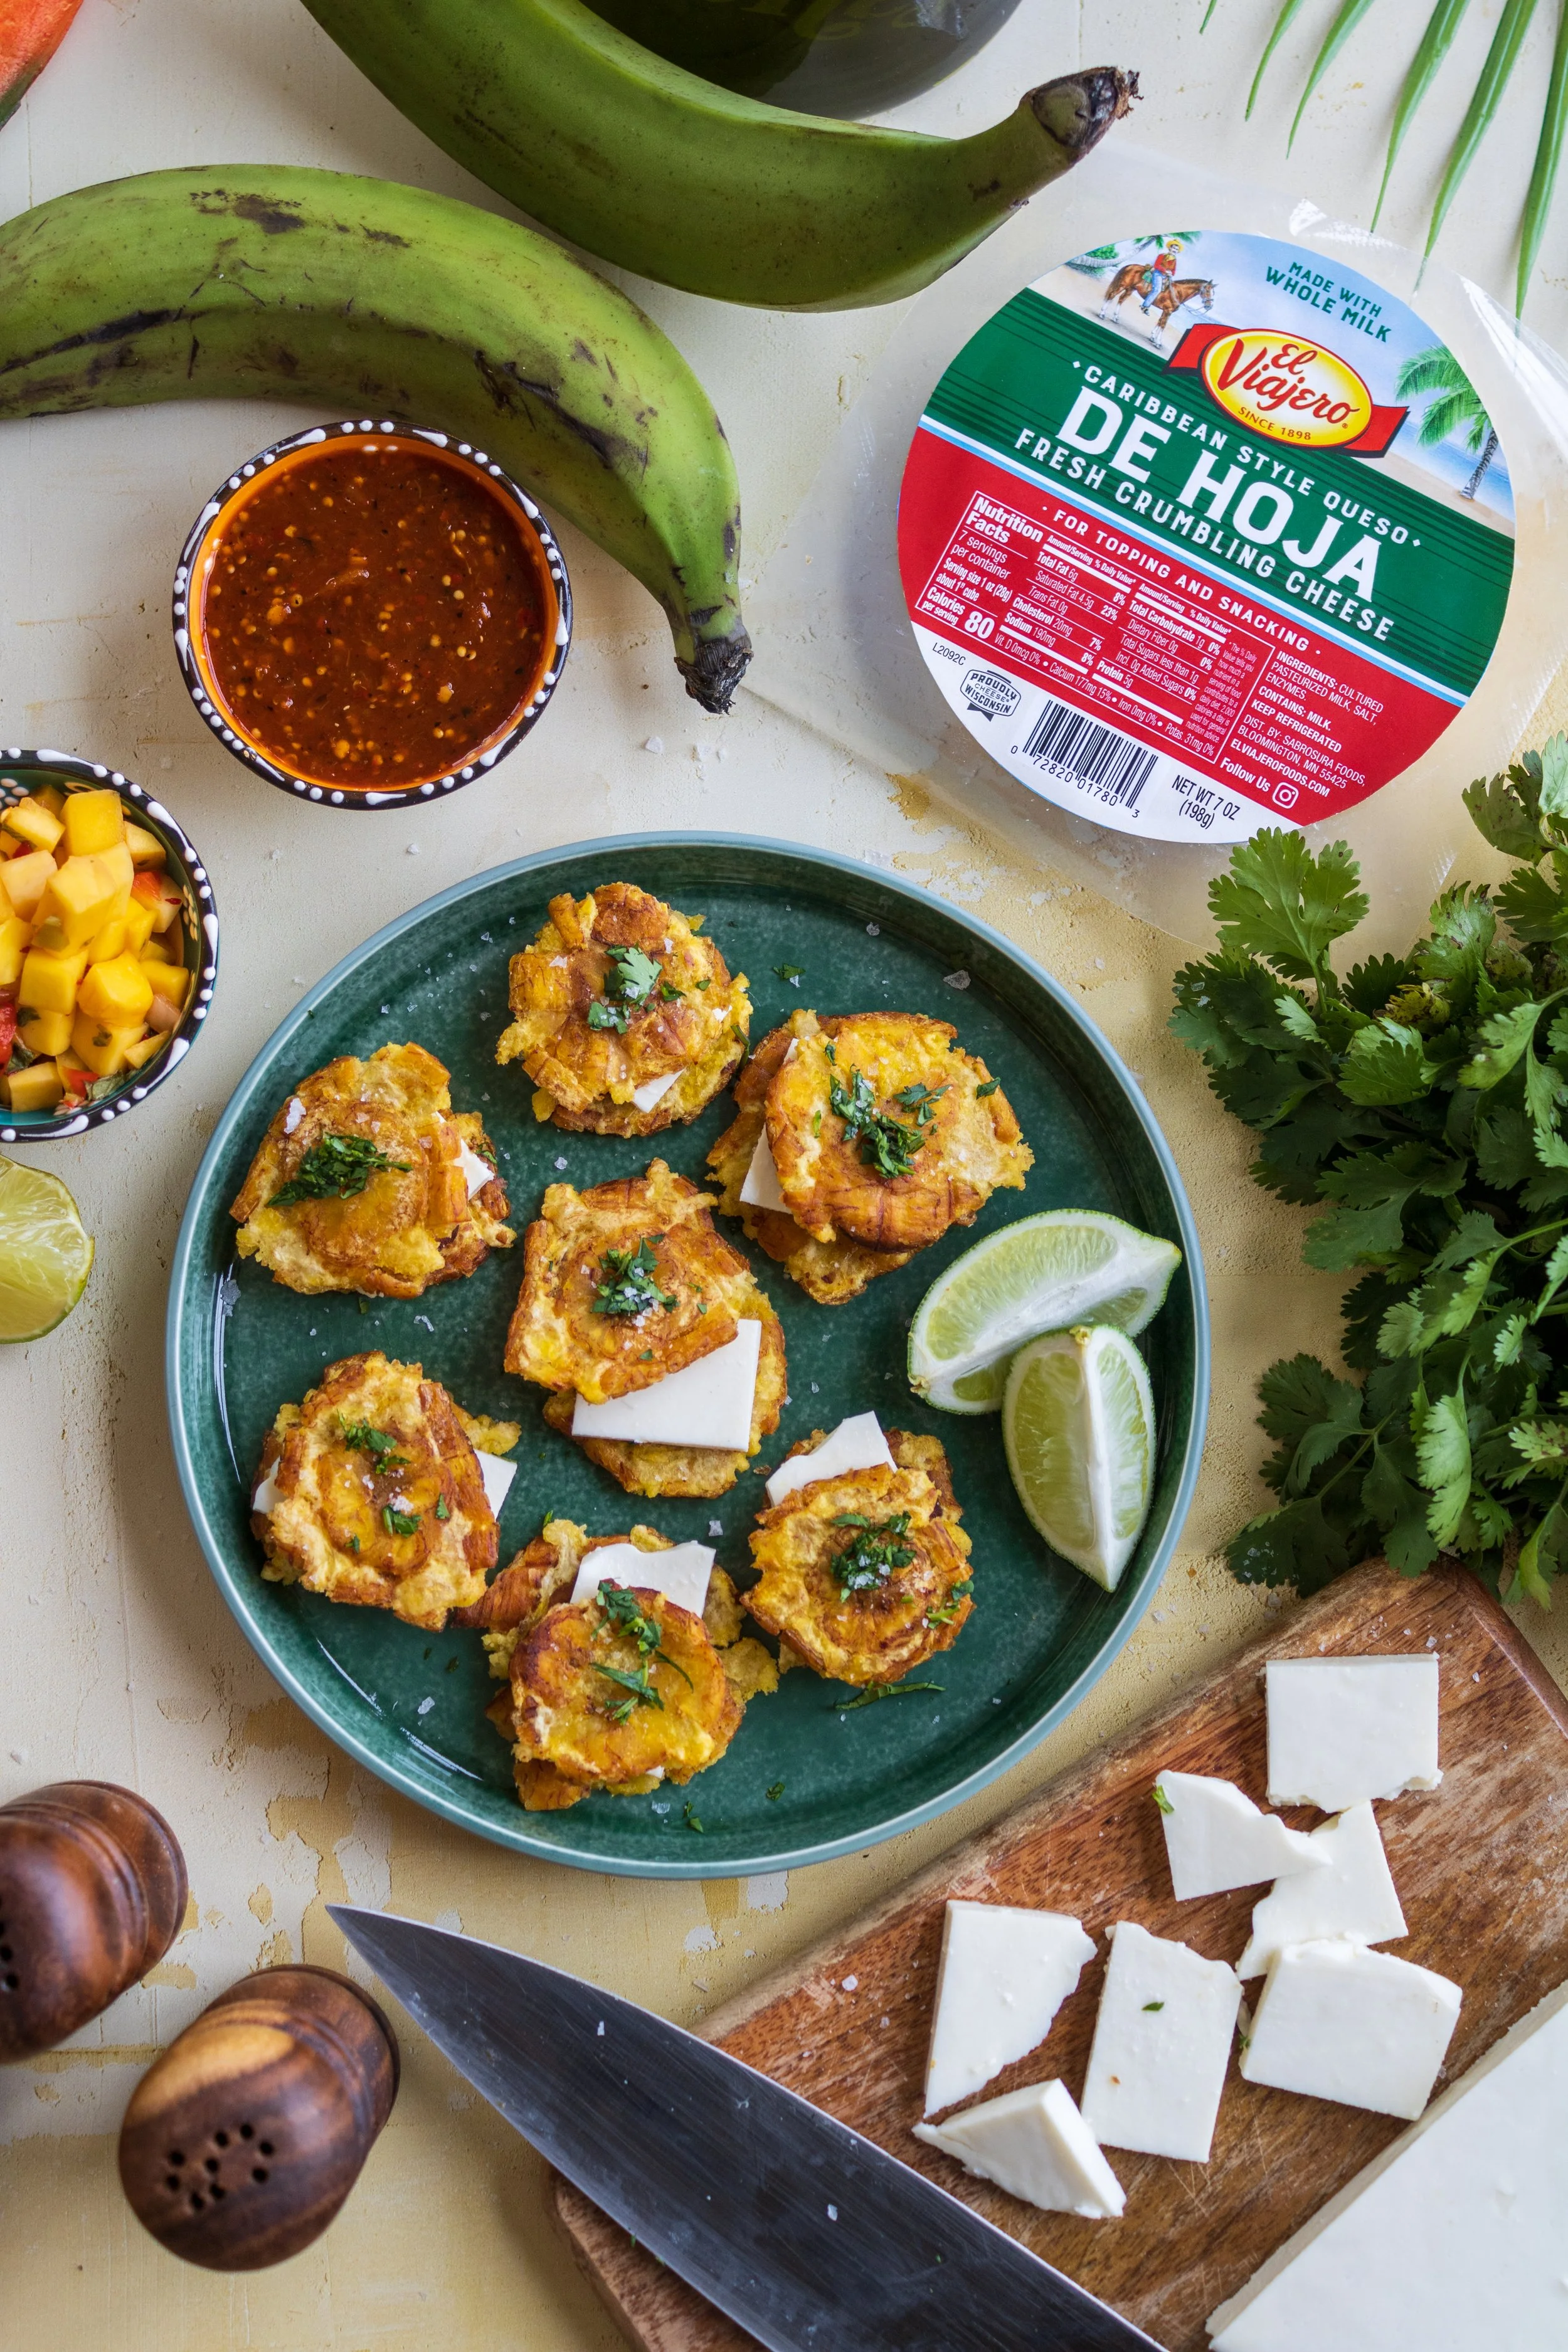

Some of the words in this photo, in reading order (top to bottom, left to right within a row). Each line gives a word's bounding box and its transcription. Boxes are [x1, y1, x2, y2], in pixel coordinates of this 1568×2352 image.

[1266, 266, 1337, 314] WHOLE
[1340, 307, 1391, 342] MILK
[1288, 262, 1335, 293] MADE
[1339, 287, 1382, 317] WITH
[1271, 344, 1318, 375] El
[1238, 407, 1276, 432] SINCE
[1280, 428, 1311, 440] 1898
[1084, 366, 1228, 450] CARIBBEAN
[1236, 445, 1315, 496] STYLE
[1323, 491, 1409, 544] QUESO
[1055, 386, 1172, 484] DE
[1175, 449, 1382, 603] HOJA
[965, 510, 1010, 543] Facts
[973, 496, 1044, 543] Nutrition
[1014, 428, 1107, 490] FRESH
[1115, 481, 1276, 578] CRUMBLING
[1285, 571, 1394, 641] CHEESE
[950, 544, 970, 558] per
[968, 553, 1011, 580] container
[958, 529, 968, 541] 7
[967, 536, 1008, 563] servings
[1047, 534, 1094, 566] Amount/Serving
[1094, 559, 1101, 568] %
[1100, 562, 1117, 578] Daily
[935, 573, 957, 590] about
[962, 587, 980, 601] cube
[943, 557, 969, 581] Serving
[966, 571, 982, 585] size
[980, 577, 988, 588] 1
[985, 581, 996, 593] oz
[992, 583, 1013, 603] (28g)
[1028, 585, 1048, 603] Trans
[1046, 595, 1059, 609] Fat
[1057, 601, 1069, 616] 0g
[1035, 570, 1069, 594] Saturated
[1066, 586, 1079, 600] Fat
[1075, 593, 1094, 612] 4.5g
[1100, 605, 1118, 621] 23%
[1037, 551, 1057, 569] Total
[1055, 561, 1070, 576] Fat
[1068, 568, 1079, 583] 6g
[1113, 591, 1126, 606] 8%
[1053, 509, 1089, 536] FOR
[1096, 530, 1170, 578] TOPPING
[1174, 575, 1213, 600] AND
[1218, 596, 1309, 651] SNACKING
[921, 600, 936, 612] per
[933, 607, 959, 626] serving
[926, 586, 966, 615] Calories
[964, 611, 995, 639] 80
[1012, 596, 1055, 625] Cholesterol
[1050, 618, 1073, 639] 20mg
[1089, 637, 1103, 651] 7%
[1138, 583, 1185, 614] Amount/Serving
[1189, 609, 1197, 618] %
[1195, 612, 1212, 627] Daily
[1004, 612, 1033, 634] Sodium
[1032, 627, 1056, 648] 190mg
[1081, 652, 1094, 666] 8%
[1127, 618, 1152, 640] Dietary
[1150, 630, 1170, 647] Fiber
[1168, 640, 1179, 654] 0g
[1200, 657, 1213, 670] 0%
[1129, 600, 1150, 617] Total
[1147, 610, 1195, 642] Carbohydrate
[1193, 635, 1205, 650] 1g
[1207, 642, 1221, 656] 0%
[932, 642, 966, 665] L2092C
[1096, 660, 1124, 682] Protein
[1123, 674, 1134, 689] 5g
[1120, 633, 1138, 650] Total
[1136, 642, 1160, 662] Sugars
[1159, 654, 1174, 670] less
[1173, 662, 1190, 677] than
[1189, 670, 1199, 684] 1g
[1217, 659, 1229, 670] how
[1227, 665, 1242, 677] much
[1222, 650, 1236, 663] Value
[1235, 657, 1246, 668] tells
[1243, 663, 1254, 672] you
[1231, 642, 1241, 654] The
[1239, 647, 1246, 657] %
[1244, 650, 1258, 664] Daily
[970, 672, 1017, 701] PROUDLY
[994, 633, 1005, 647] Vit.
[1004, 638, 1013, 649] D
[1010, 642, 1030, 661] 0mcg
[1029, 651, 1042, 665] 0%
[1049, 662, 1075, 682] Calcium
[1074, 675, 1098, 696] 177mg
[1096, 687, 1113, 702] 15%
[1118, 697, 1132, 712] Iron
[1130, 704, 1147, 722] 0mg
[1145, 712, 1158, 726] 0%
[1165, 723, 1184, 741] Potas.
[1184, 733, 1204, 752] 31mg
[1202, 743, 1215, 756] 0%
[1115, 650, 1131, 666] Incl.
[1130, 659, 1141, 673] 0g
[1139, 664, 1163, 682] Added
[1160, 674, 1185, 694] Sugars
[1184, 687, 1197, 701] 0%
[1204, 686, 1229, 704] contributes
[1228, 698, 1235, 706] to
[1208, 677, 1226, 692] serving
[1230, 687, 1242, 699] food
[1213, 669, 1232, 683] nutrient
[1230, 676, 1237, 685] in
[1265, 672, 1307, 701] ENZYMES.
[1271, 661, 1328, 697] PASTEURIZED
[1328, 691, 1352, 712] MILK,
[1353, 705, 1377, 726] SALT,
[1276, 650, 1338, 689] INGREDIENTS:
[1338, 684, 1384, 713] CULTURED
[965, 684, 1012, 714] WISCONSIN
[1194, 703, 1214, 718] calories
[1216, 714, 1226, 725] day
[1224, 718, 1231, 726] is
[1199, 694, 1212, 706] daily
[1210, 700, 1221, 711] diet.
[1220, 704, 1236, 718] 2,000
[1258, 686, 1306, 717] CONTAINS:
[1306, 711, 1332, 731] MILK.
[1185, 721, 1205, 735] nutrition
[1204, 731, 1220, 743] advice.
[1190, 712, 1204, 723] used
[1201, 716, 1210, 726] for
[1207, 722, 1227, 736] general
[1251, 699, 1276, 716] KEEP
[1275, 711, 1342, 753] REFRIGERATED
[1230, 738, 1330, 797] ELVIAJEROFOODS.COM
[1237, 724, 1301, 767] BLOOMINGTON,
[1303, 759, 1320, 774] MN
[1319, 768, 1348, 789] 55425
[1243, 714, 1266, 733] DIST.
[1266, 726, 1282, 741] BY:
[1283, 735, 1334, 769] SABROSURA
[1334, 763, 1365, 787] FOODS,
[1220, 757, 1256, 783] Follow
[1256, 776, 1271, 792] Us
[1171, 775, 1197, 797] NET
[1195, 786, 1216, 806] WT
[1213, 797, 1224, 811] 7
[1222, 802, 1241, 821] OZ
[1179, 799, 1215, 830] (198g)
